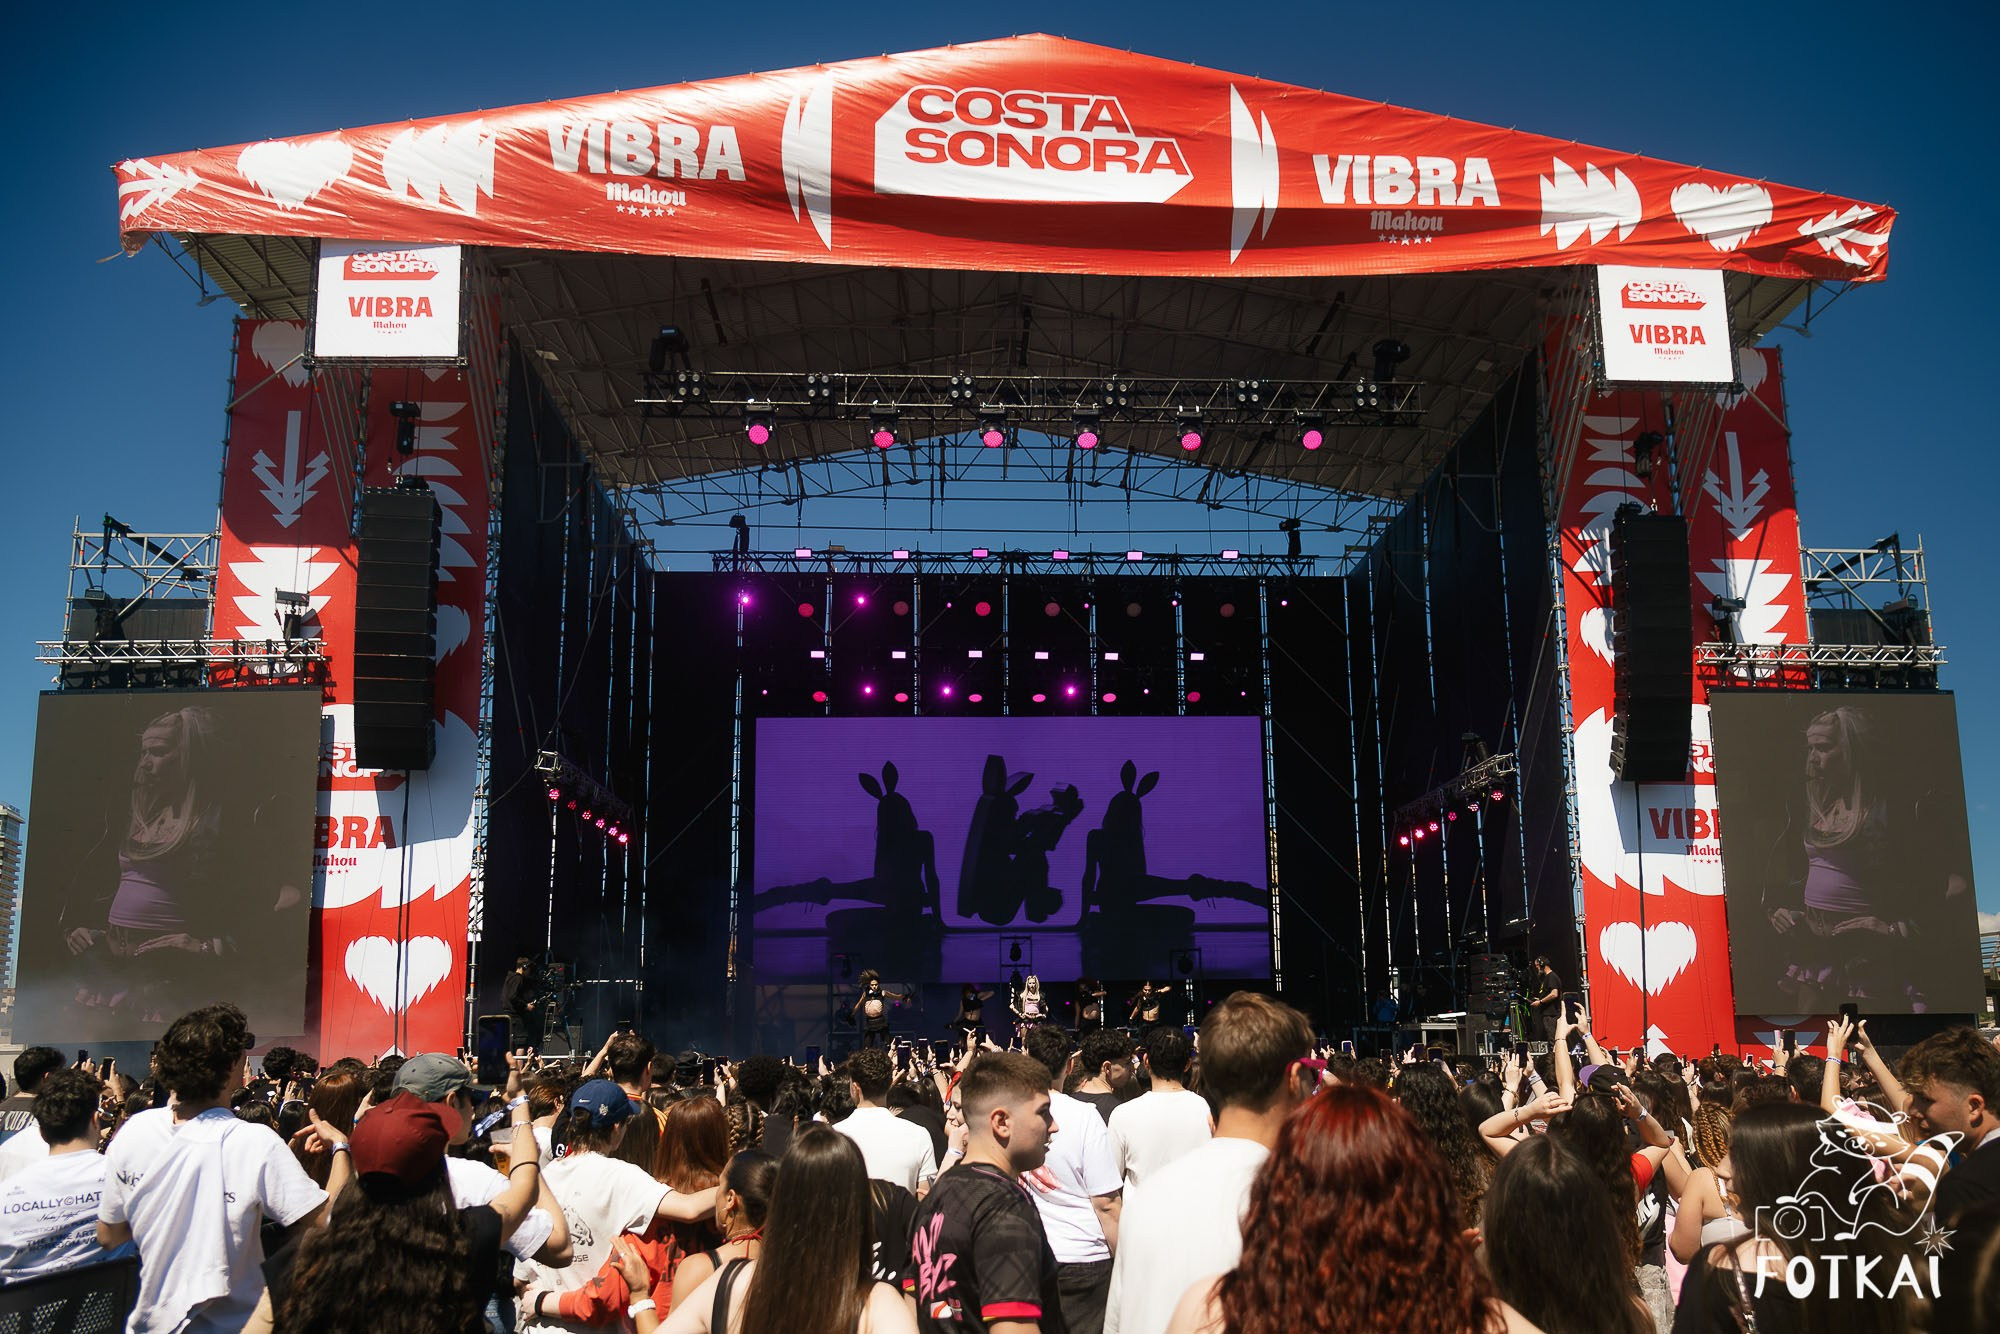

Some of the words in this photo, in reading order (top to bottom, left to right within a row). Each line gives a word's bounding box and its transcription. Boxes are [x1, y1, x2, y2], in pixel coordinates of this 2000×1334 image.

[907, 88, 1131, 133] COSTA
[547, 119, 746, 181] VIBRA
[905, 128, 1190, 175] SONORA
[1312, 154, 1501, 206] VIBRA
[605, 182, 687, 207] Mahou
[1370, 210, 1443, 231] Mahou
[352, 250, 422, 261] COSTA
[351, 261, 440, 273] SONORA
[1627, 280, 1689, 291] COSTA
[1627, 290, 1708, 303] SONORA
[348, 297, 433, 318] VIBRA
[373, 321, 407, 329] Mahou
[1629, 324, 1706, 345] VIBRA
[1654, 347, 1684, 356] Mahou
[315, 816, 397, 849] BRA
[1648, 808, 1721, 839] VIB
[1685, 845, 1721, 856] Maho
[4, 1191, 102, 1214] LOCALLY©HAT
